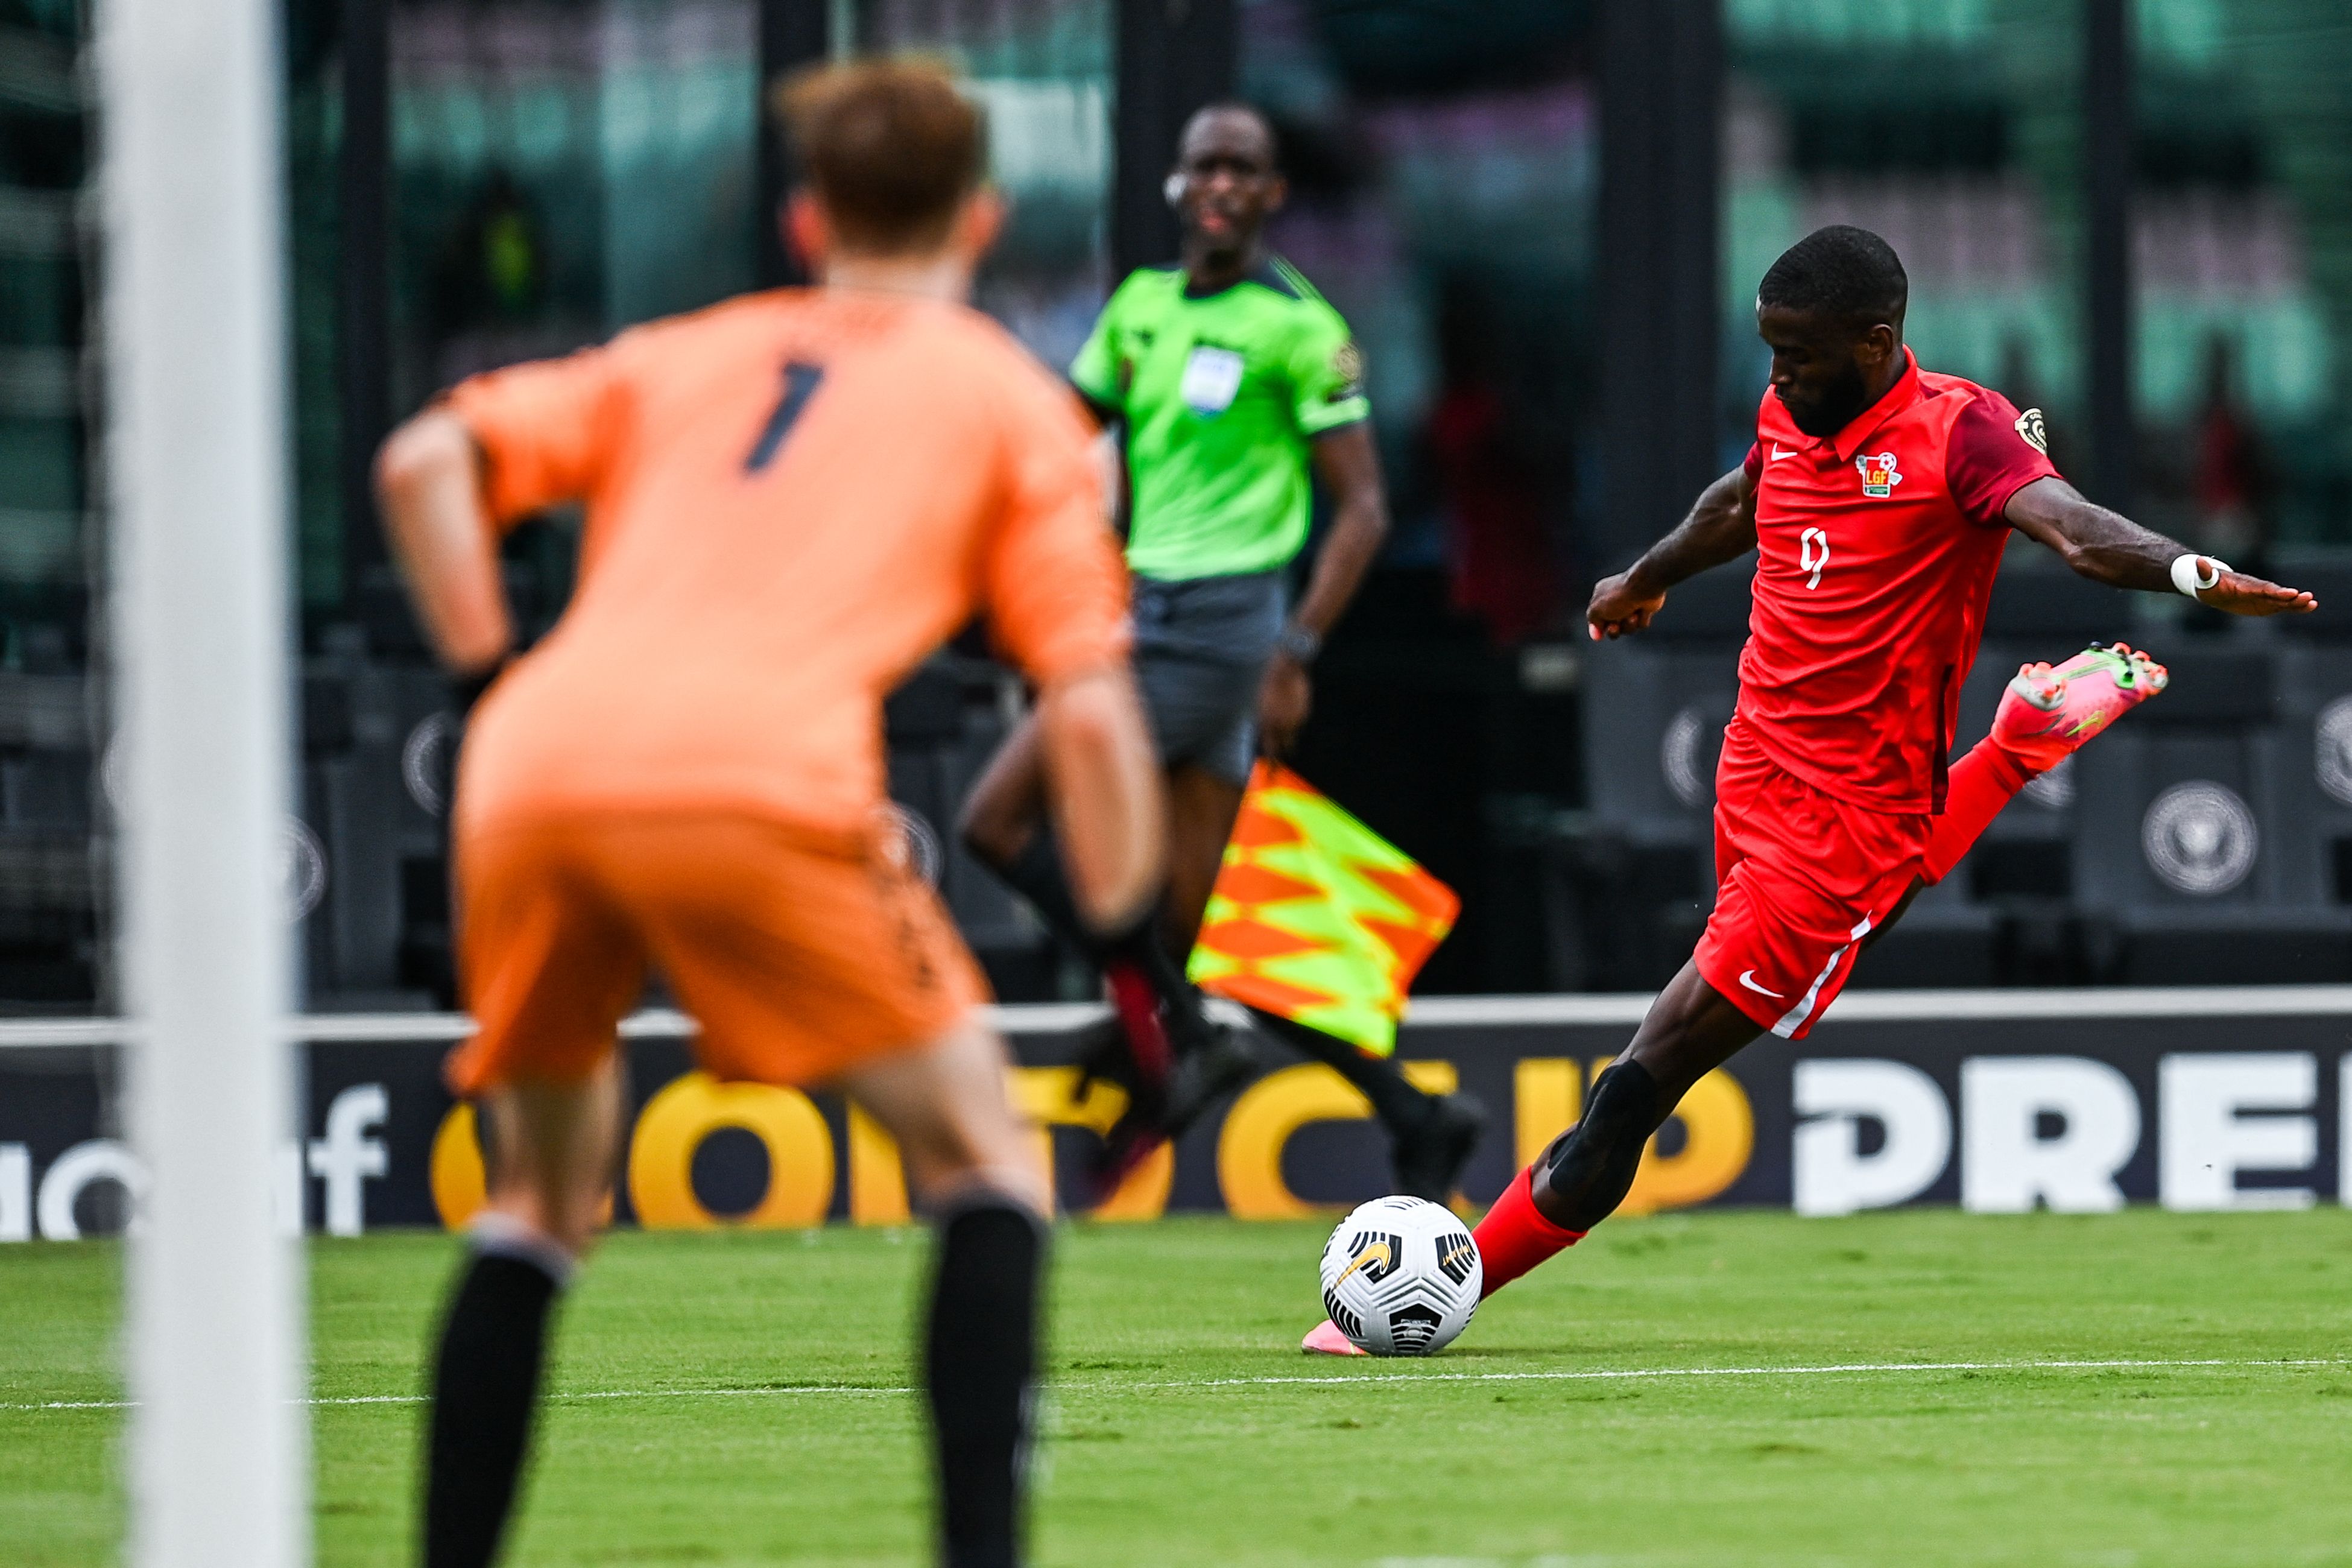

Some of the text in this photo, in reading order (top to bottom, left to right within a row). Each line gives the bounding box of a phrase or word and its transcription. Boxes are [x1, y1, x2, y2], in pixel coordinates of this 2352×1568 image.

[745, 358, 824, 473] 1
[1866, 469, 1888, 484] LGF
[1800, 527, 1829, 590] 9
[1791, 1051, 2352, 1216] PRE
